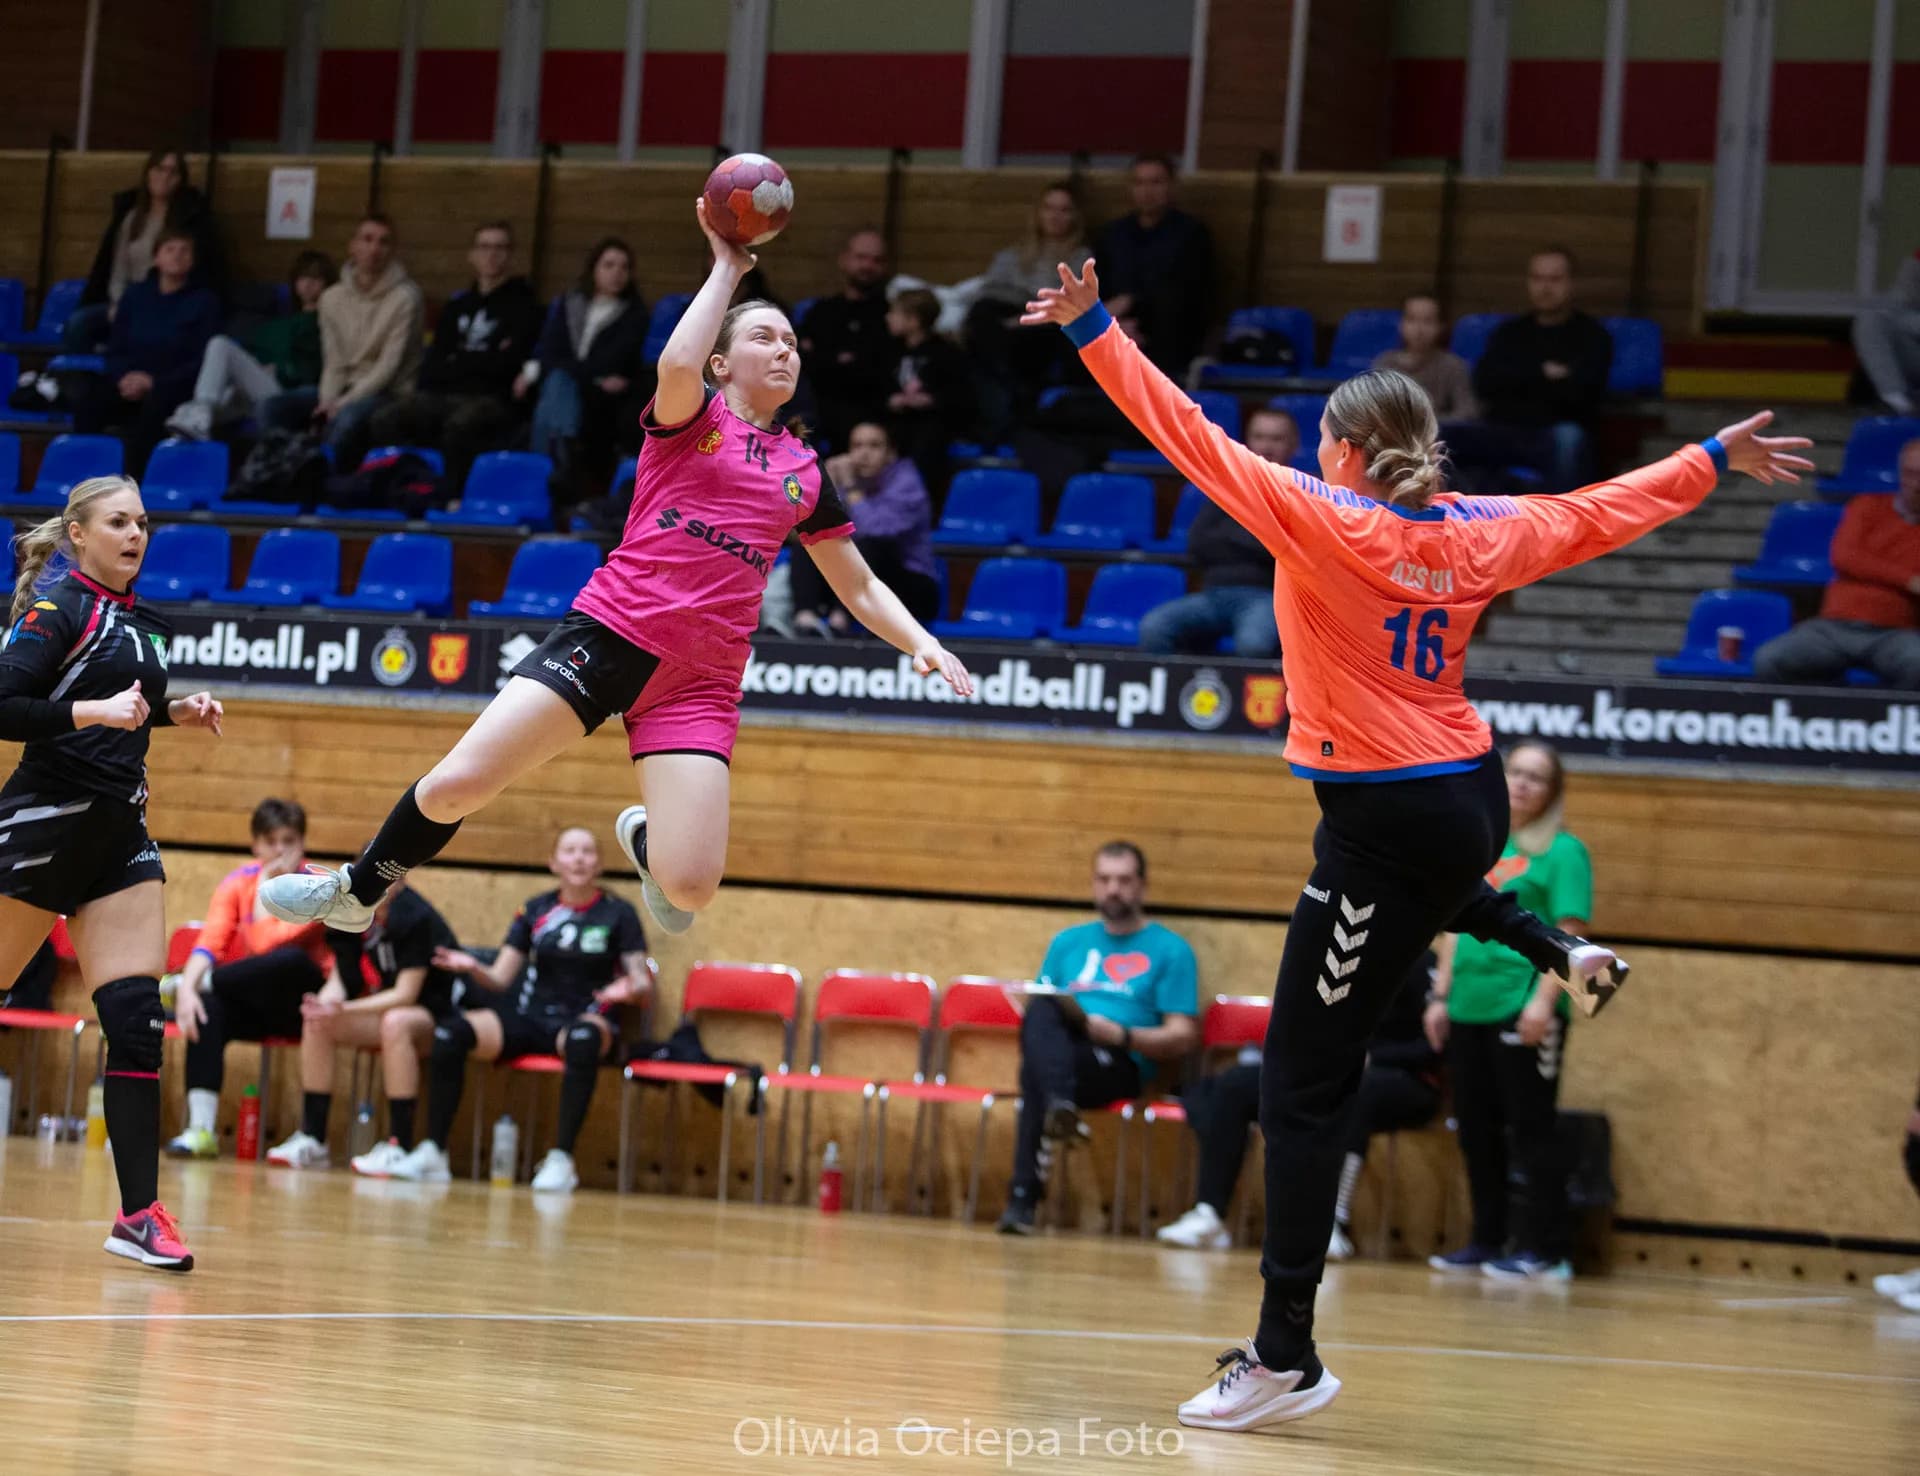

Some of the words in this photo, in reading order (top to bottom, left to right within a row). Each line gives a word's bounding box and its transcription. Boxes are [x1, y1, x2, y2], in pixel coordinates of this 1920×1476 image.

[745, 431, 770, 473] 14
[168, 620, 359, 686] ndball.pl
[1383, 607, 1449, 682] 16
